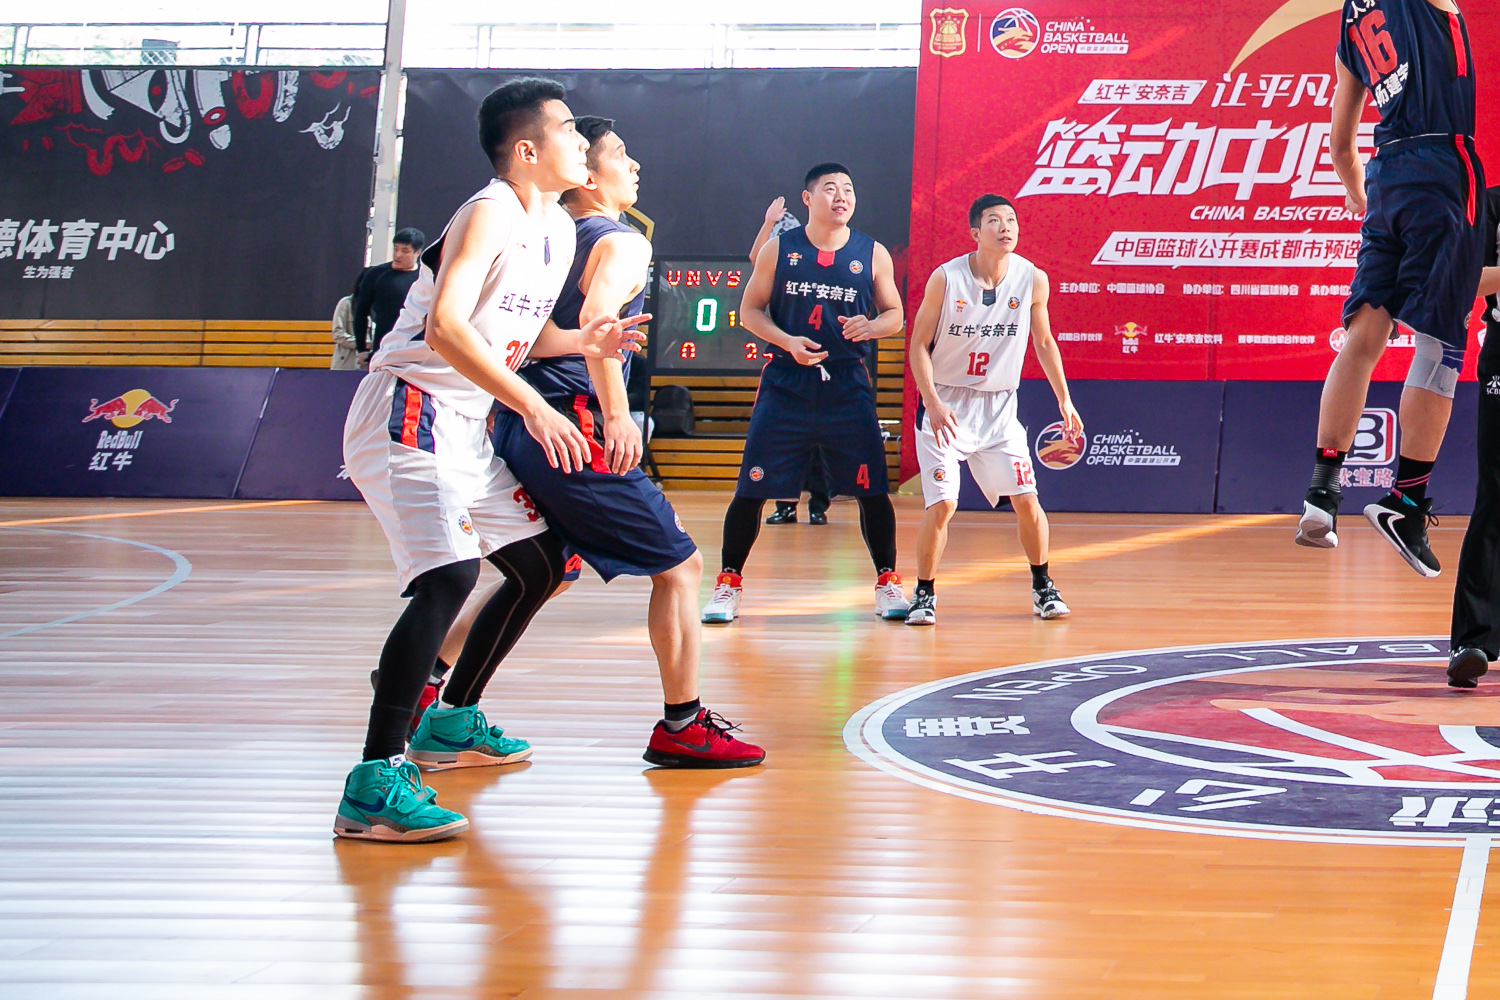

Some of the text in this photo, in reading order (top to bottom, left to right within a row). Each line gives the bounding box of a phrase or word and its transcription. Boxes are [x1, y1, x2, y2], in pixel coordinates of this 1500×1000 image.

[1045, 21, 1085, 32] CHINA
[1043, 32, 1129, 43] BASKETBALL
[1040, 43, 1075, 54] OPEN
[1348, 9, 1398, 86] 16
[1210, 72, 1378, 109] 让平凡
[1190, 205, 1245, 221] CHINA
[22, 265, 75, 280] 生为强者
[695, 298, 718, 333] 0
[808, 304, 823, 331] 4
[966, 351, 990, 377] 12
[1093, 434, 1133, 445] CHINA
[1089, 444, 1178, 456] BASKETBALL
[88, 451, 133, 471] 红牛
[1086, 455, 1122, 466] OPEN
[856, 463, 870, 489] 4
[1013, 460, 1034, 486] 12
